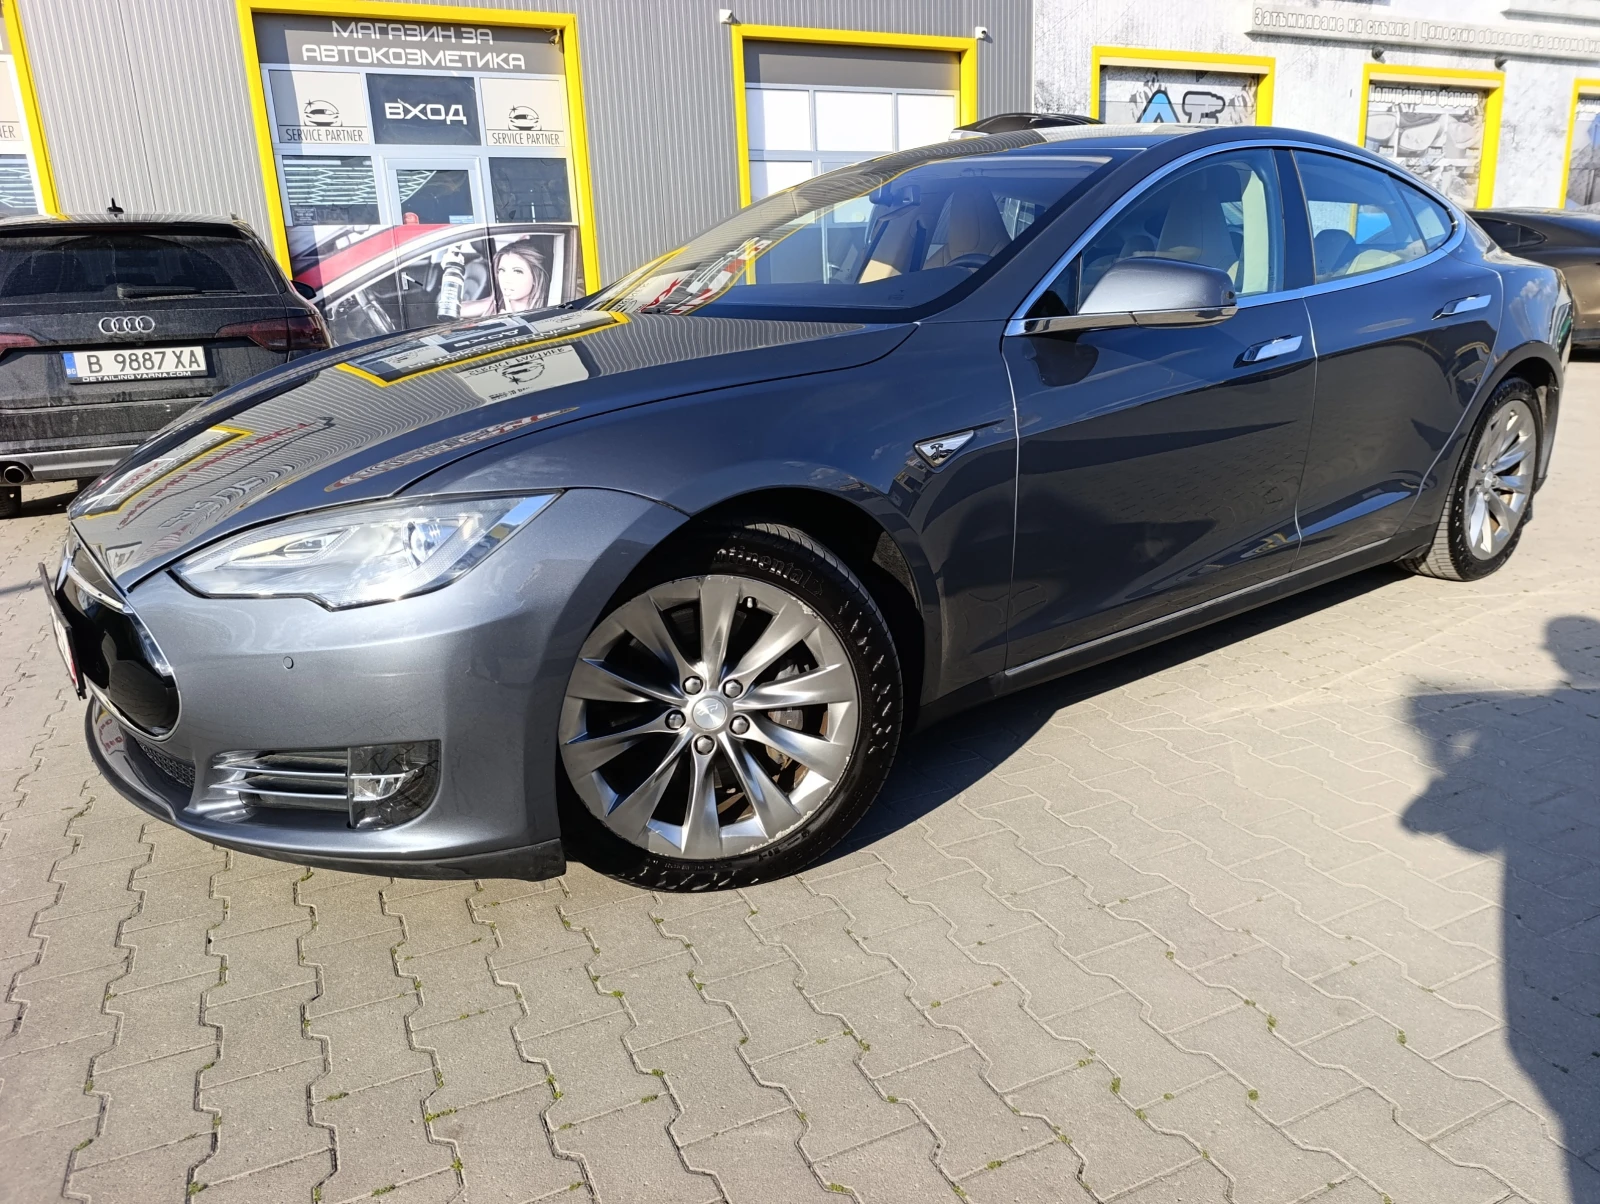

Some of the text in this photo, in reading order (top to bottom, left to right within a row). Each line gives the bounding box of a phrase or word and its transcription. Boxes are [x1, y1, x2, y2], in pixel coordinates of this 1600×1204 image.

[331, 20, 493, 45] МАГАЗИН ЗА
[1254, 7, 1344, 32] Затъмняване
[1348, 18, 1362, 34] на
[1366, 20, 1410, 37] стъкла
[1421, 22, 1475, 43] Цялостно
[1532, 34, 1544, 49] на
[302, 44, 525, 70] АВТОКОЗМЕТИКА
[1423, 90, 1437, 105] на
[1438, 90, 1478, 108] фарове
[385, 102, 467, 125] ВХОД
[287, 128, 364, 143] SERVICE PARTNER
[493, 132, 560, 145] SERVICE PARTNER
[87, 350, 201, 373] B 9887 XA
